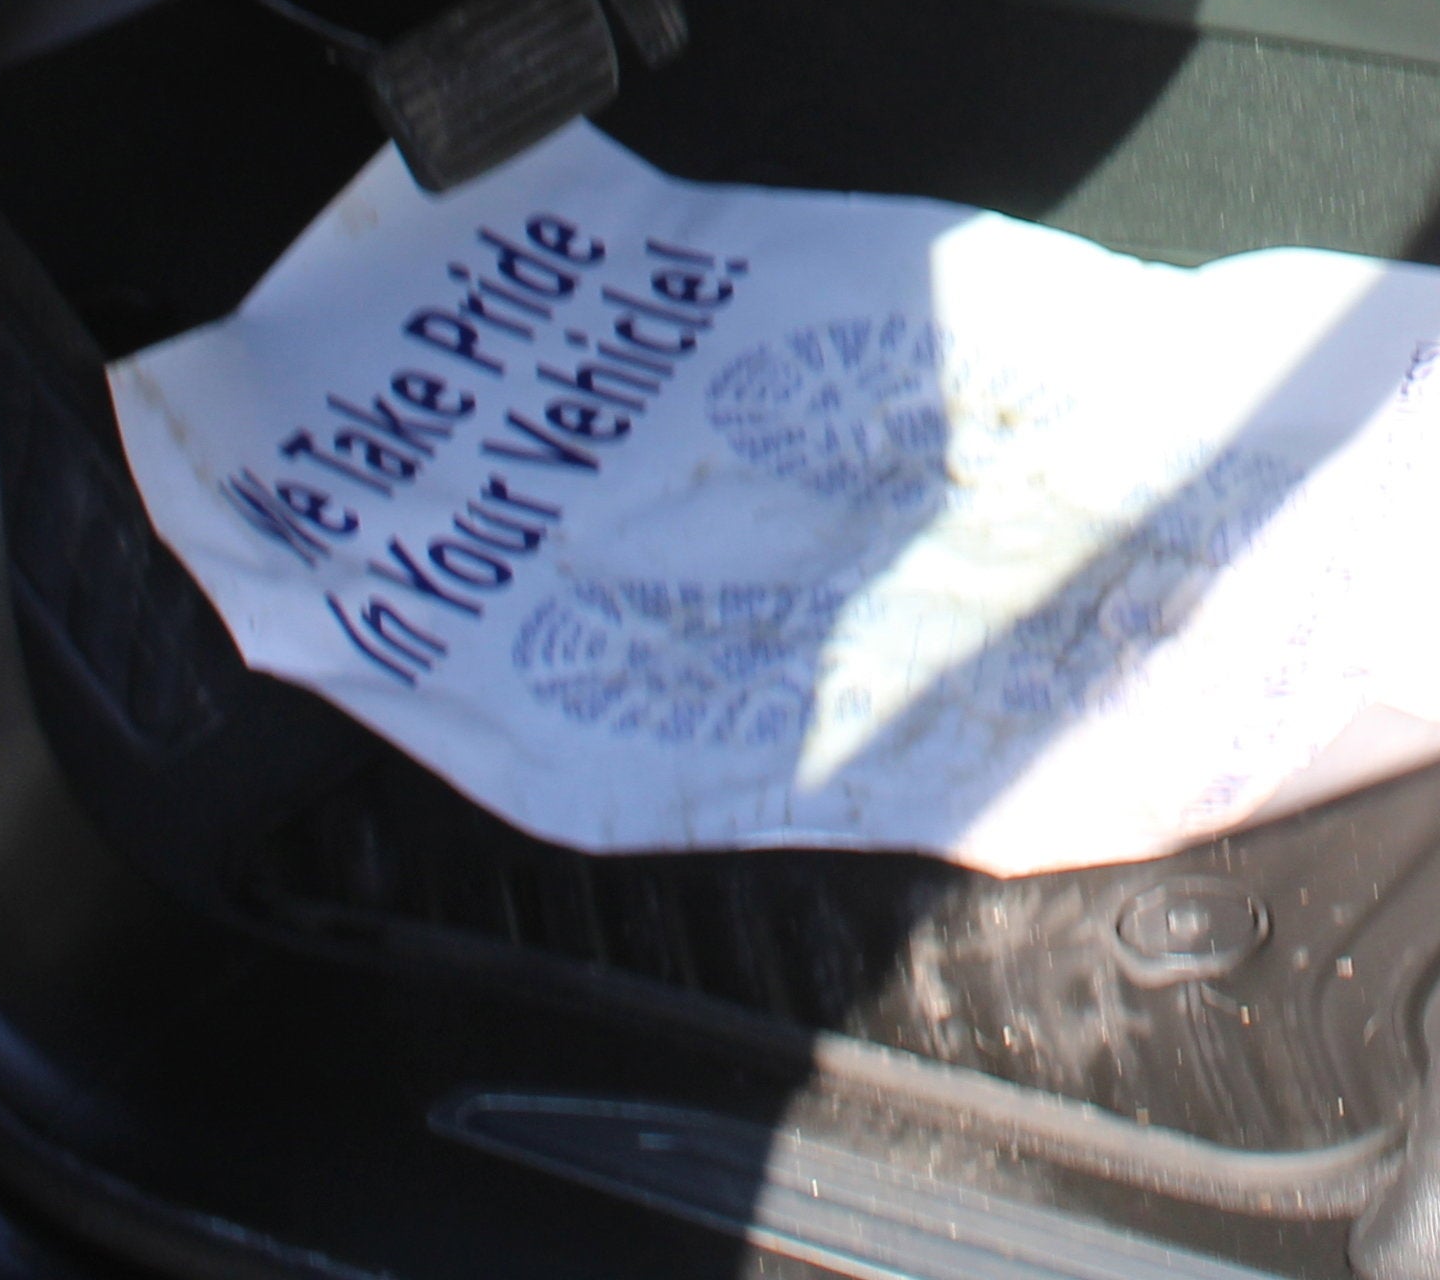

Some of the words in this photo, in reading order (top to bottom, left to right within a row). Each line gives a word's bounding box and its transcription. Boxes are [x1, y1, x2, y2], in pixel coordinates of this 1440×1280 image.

[403, 213, 606, 376] Pride
[480, 238, 750, 474] Vehicle!
[279, 367, 476, 497] Take
[220, 467, 359, 569] We
[367, 474, 561, 618] Your
[326, 591, 448, 688] In
